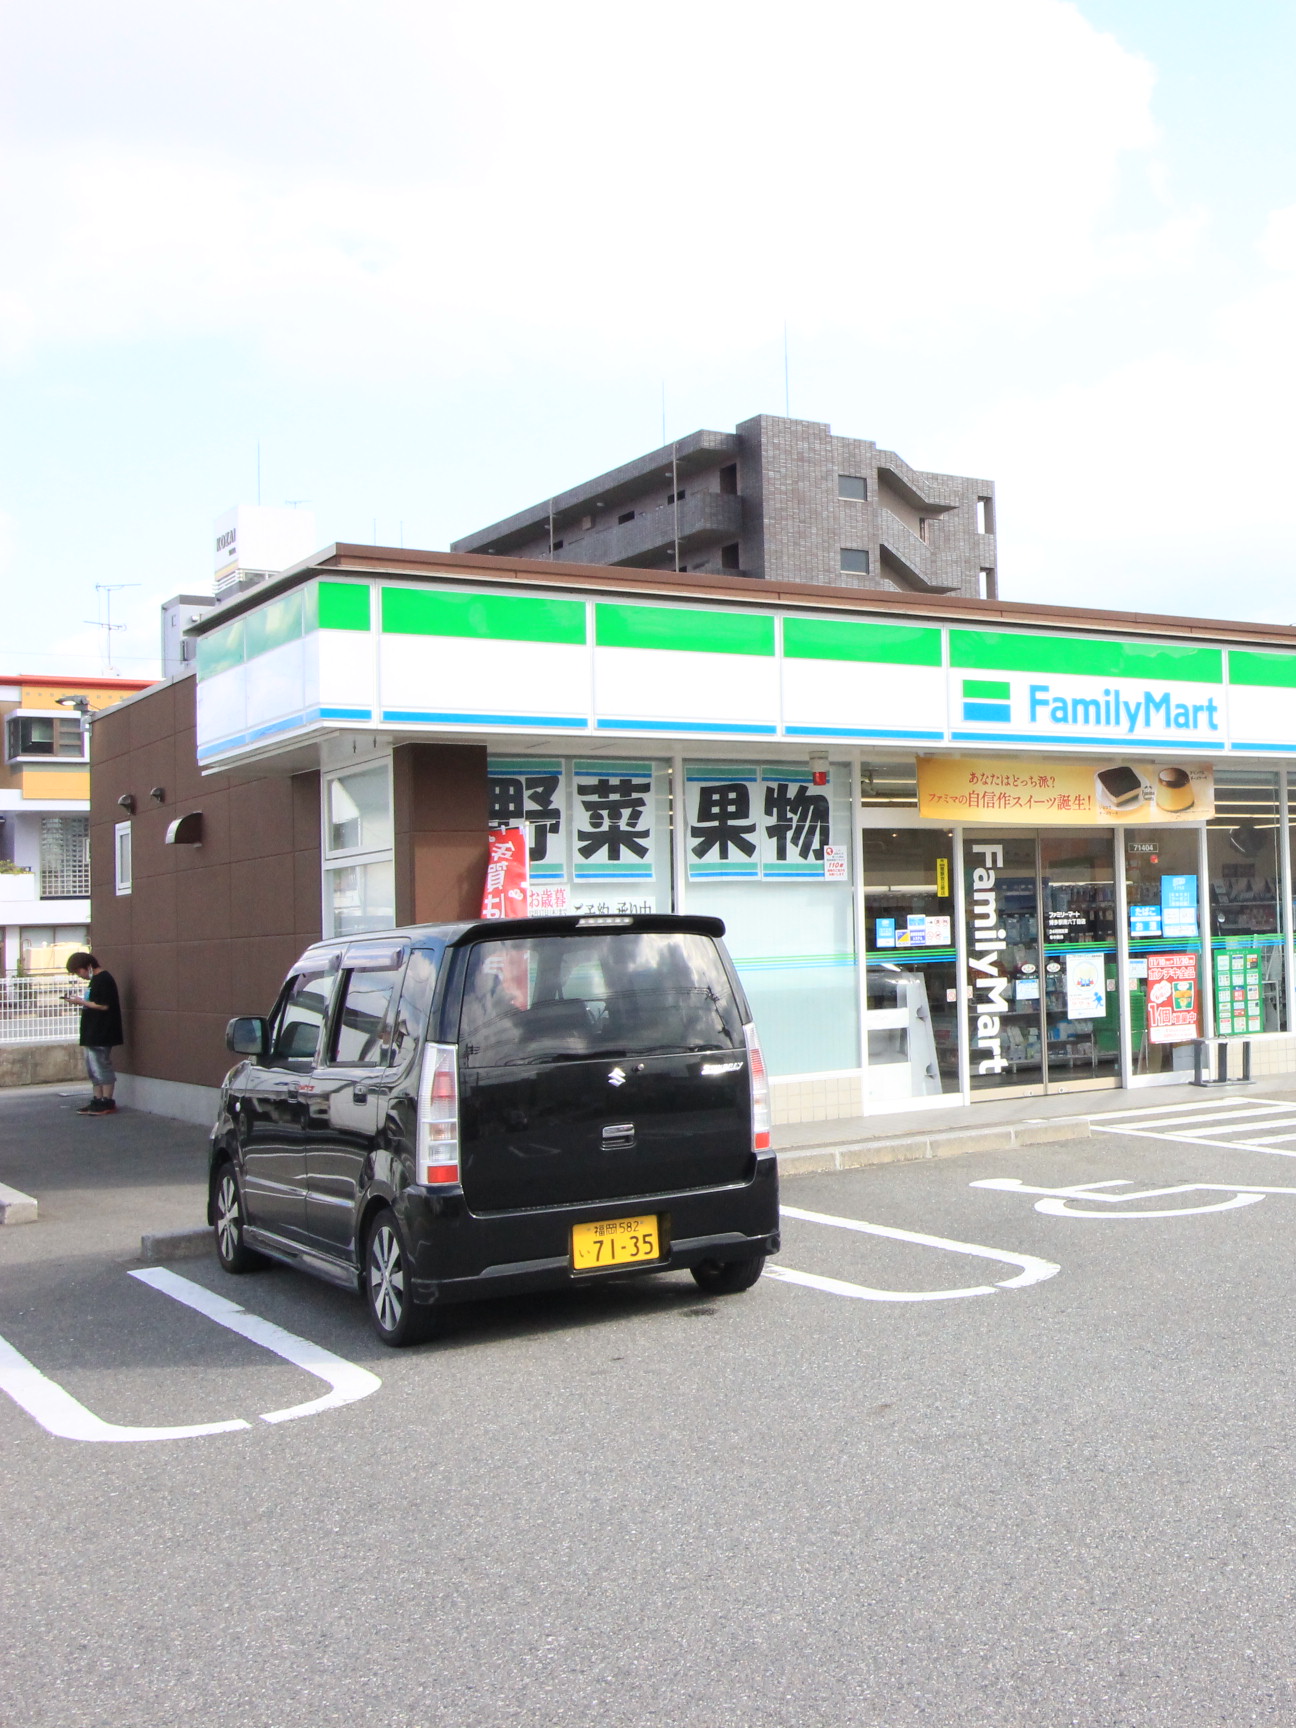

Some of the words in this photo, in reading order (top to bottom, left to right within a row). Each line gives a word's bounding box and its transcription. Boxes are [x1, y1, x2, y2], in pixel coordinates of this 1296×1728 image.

[1028, 684, 1220, 733] FamilyMart
[690, 782, 831, 861] 果物
[1133, 844, 1154, 852] 71404
[969, 844, 1009, 1075] FamilyMart
[593, 1233, 654, 1263] 71-35
